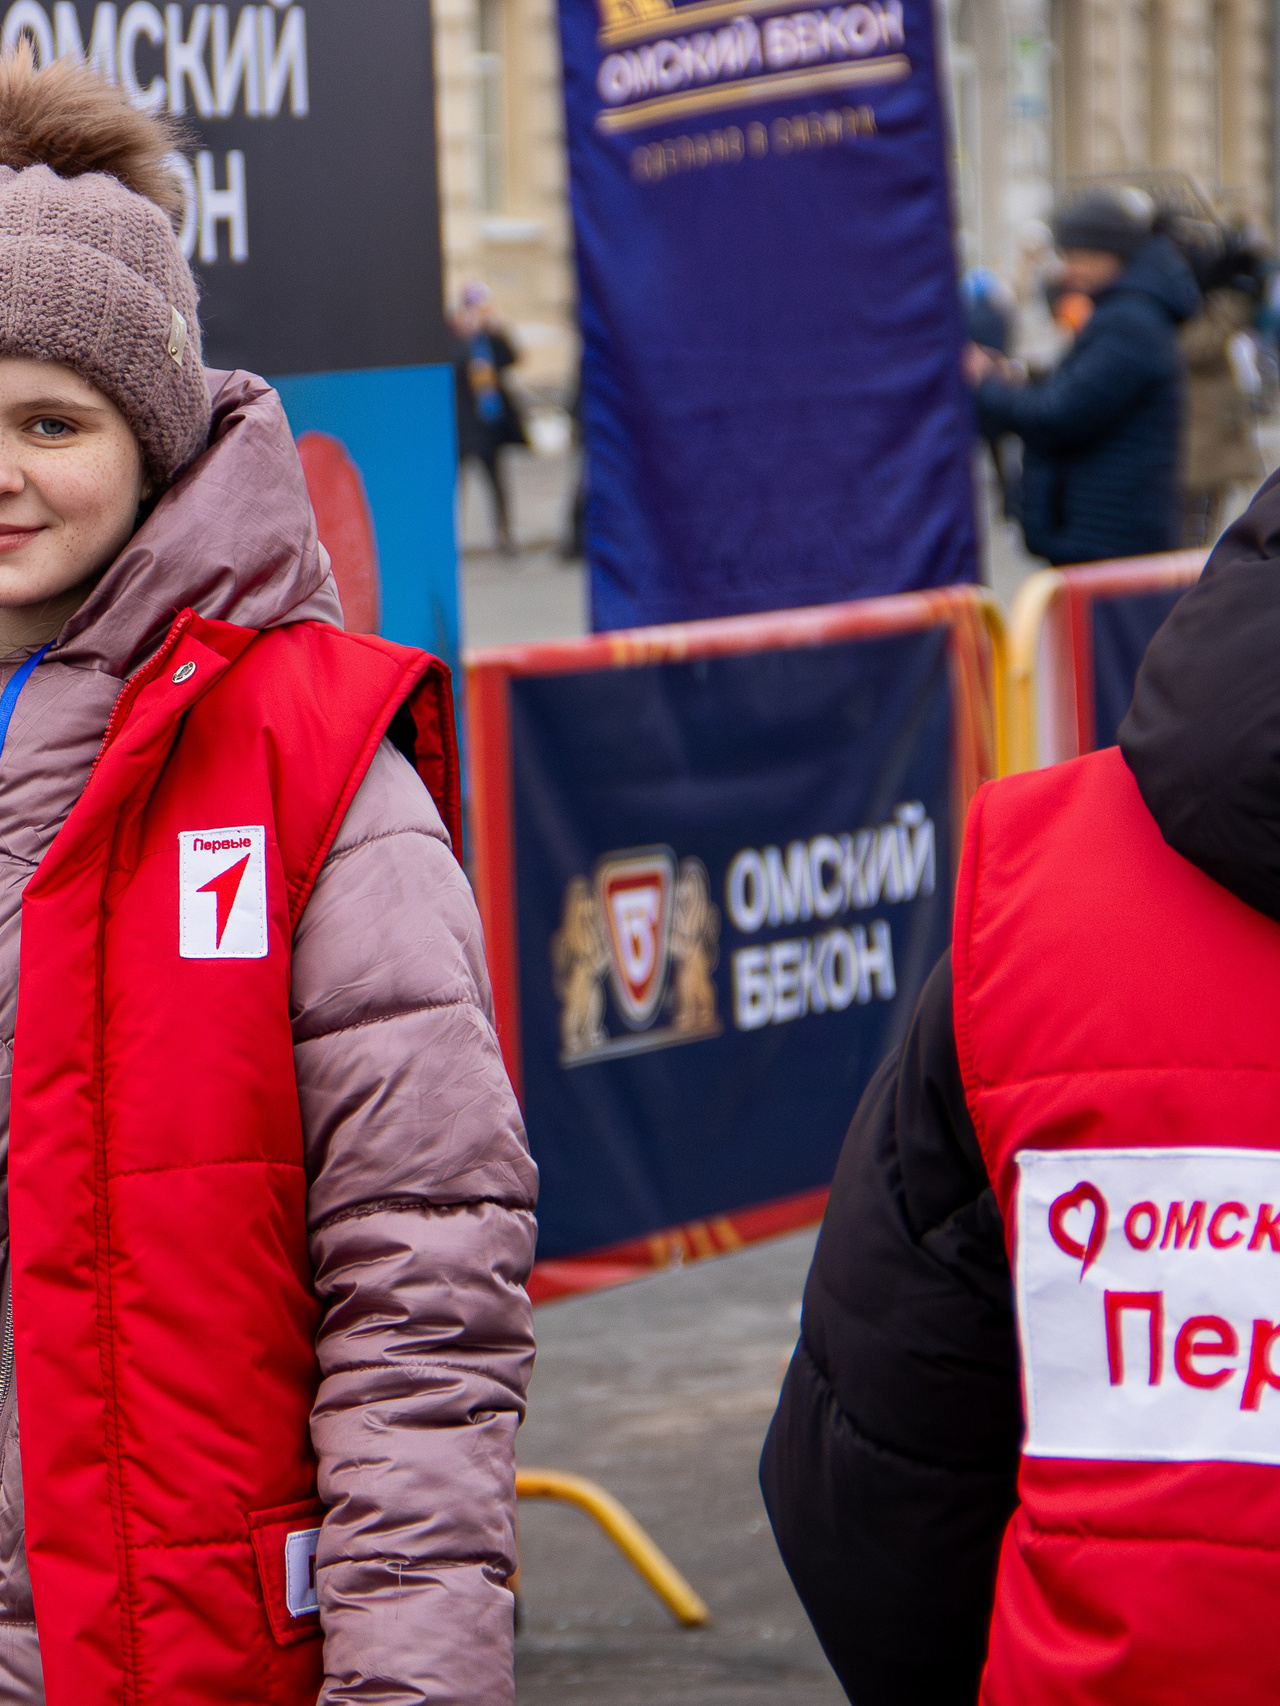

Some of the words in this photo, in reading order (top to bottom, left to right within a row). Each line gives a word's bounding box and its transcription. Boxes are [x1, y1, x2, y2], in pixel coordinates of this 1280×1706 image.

[193, 838, 252, 854] Первые
[726, 803, 935, 932] ОМСКИЙ
[732, 920, 896, 1032] БЕКОН
